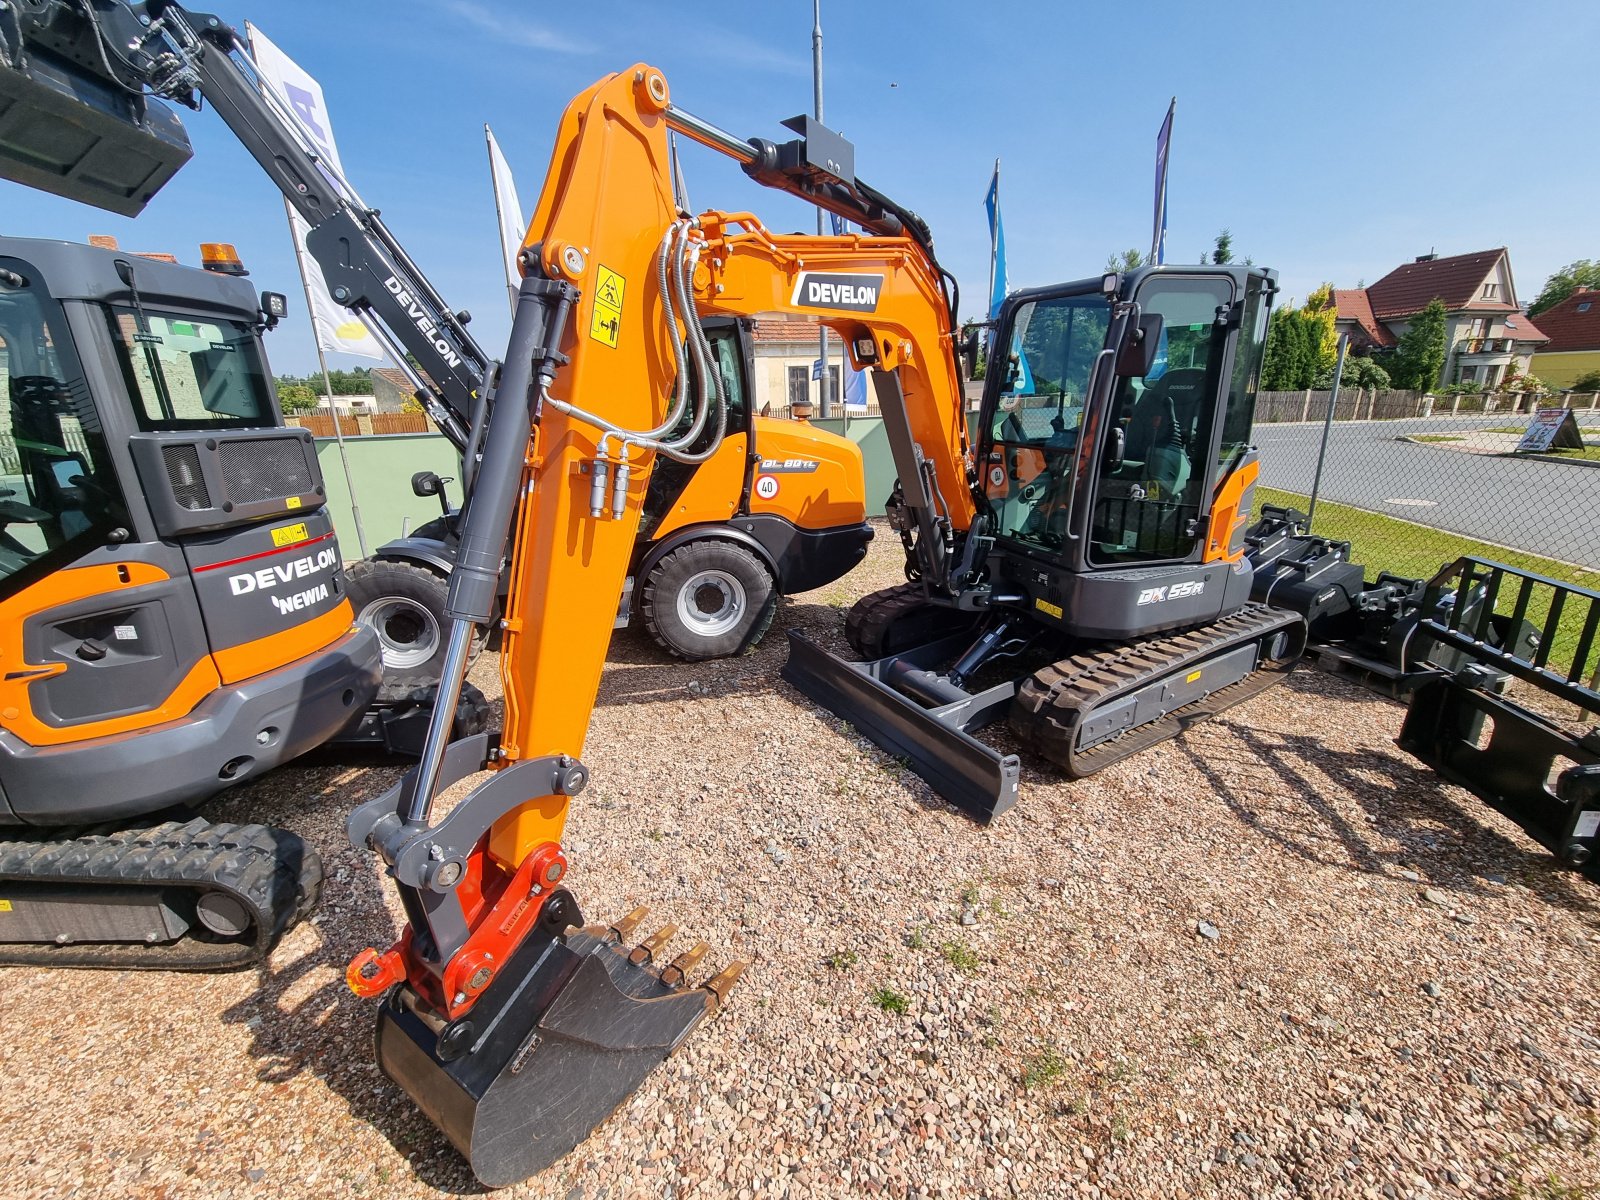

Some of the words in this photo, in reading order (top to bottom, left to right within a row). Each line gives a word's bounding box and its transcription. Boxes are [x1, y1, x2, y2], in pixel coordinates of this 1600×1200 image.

[808, 282, 876, 305] DEVELON
[384, 276, 461, 368] DEVELON
[761, 481, 773, 493] 40
[229, 547, 336, 596] DEVELON
[278, 583, 329, 615] NEWIA
[1137, 585, 1168, 606] DX
[1168, 581, 1205, 600] 55R
